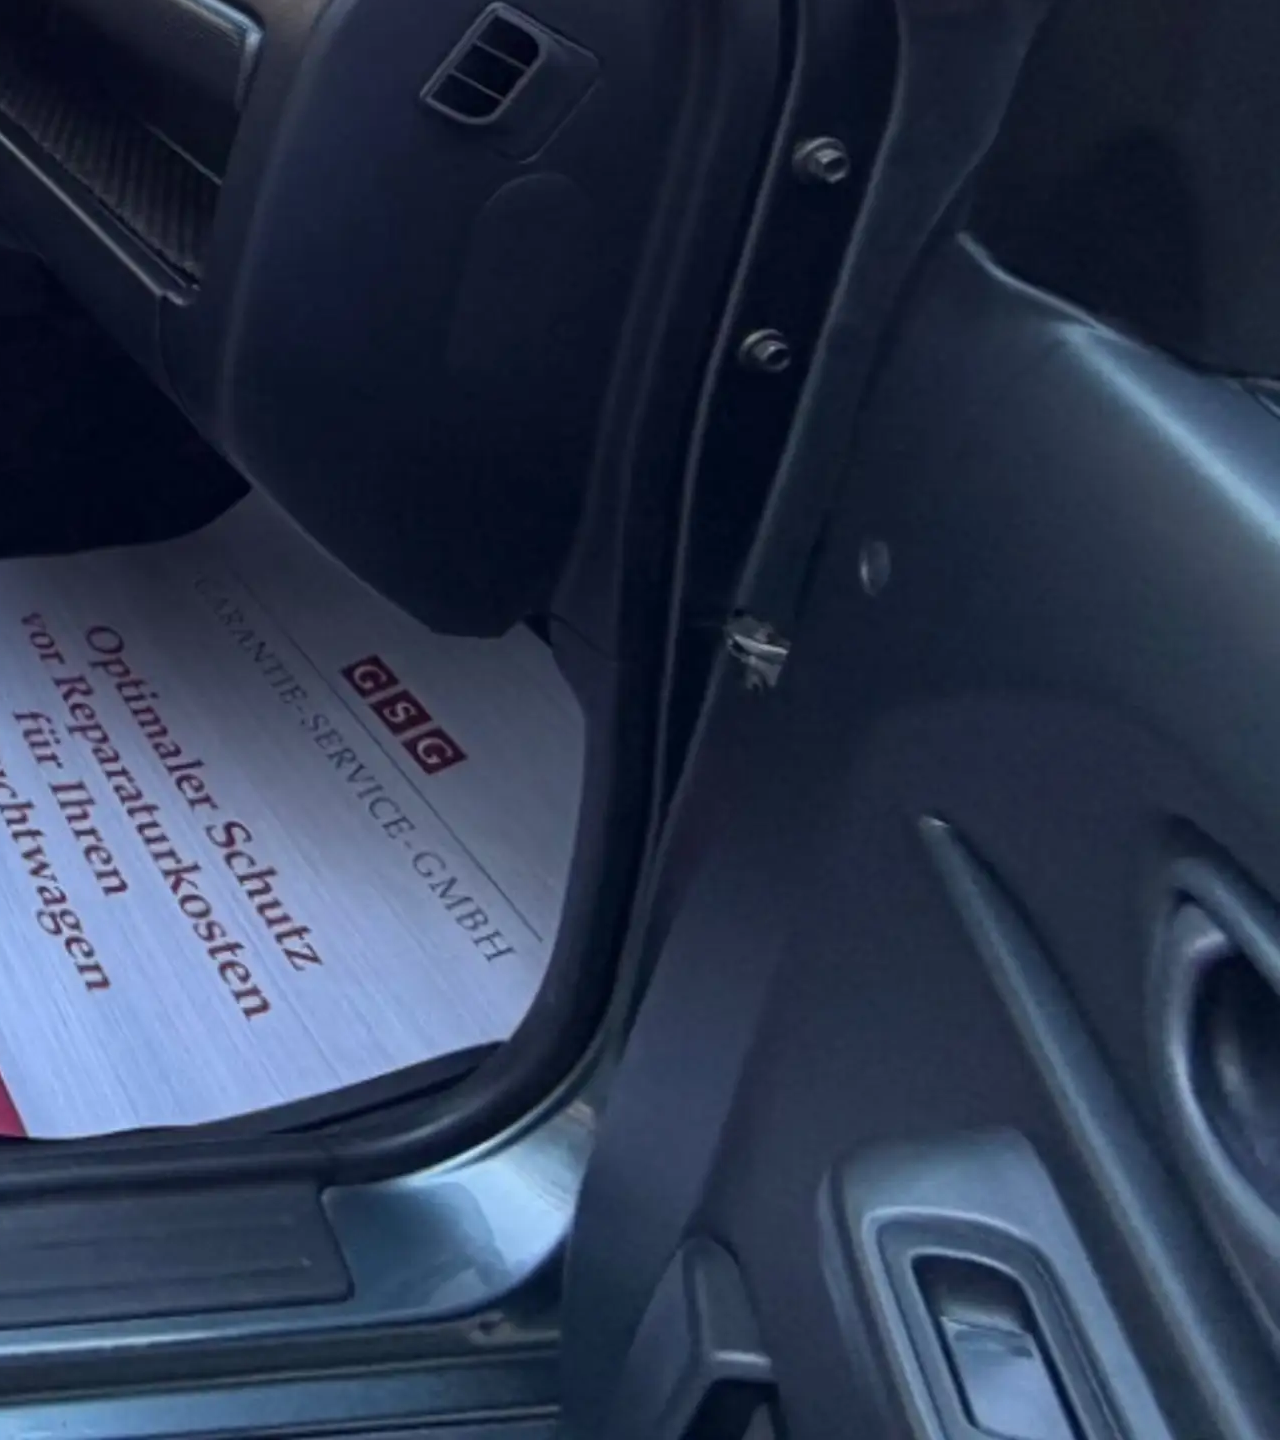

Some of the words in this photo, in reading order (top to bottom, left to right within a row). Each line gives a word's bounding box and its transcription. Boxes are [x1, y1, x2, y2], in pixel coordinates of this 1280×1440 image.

[12, 709, 63, 769] für
[49, 780, 128, 897] Ihren
[21, 612, 65, 665] vor
[53, 675, 272, 1020] Reparaturkosten
[85, 625, 218, 812] Optimaler
[206, 820, 323, 971] Schutz
[347, 658, 460, 770] GSG
